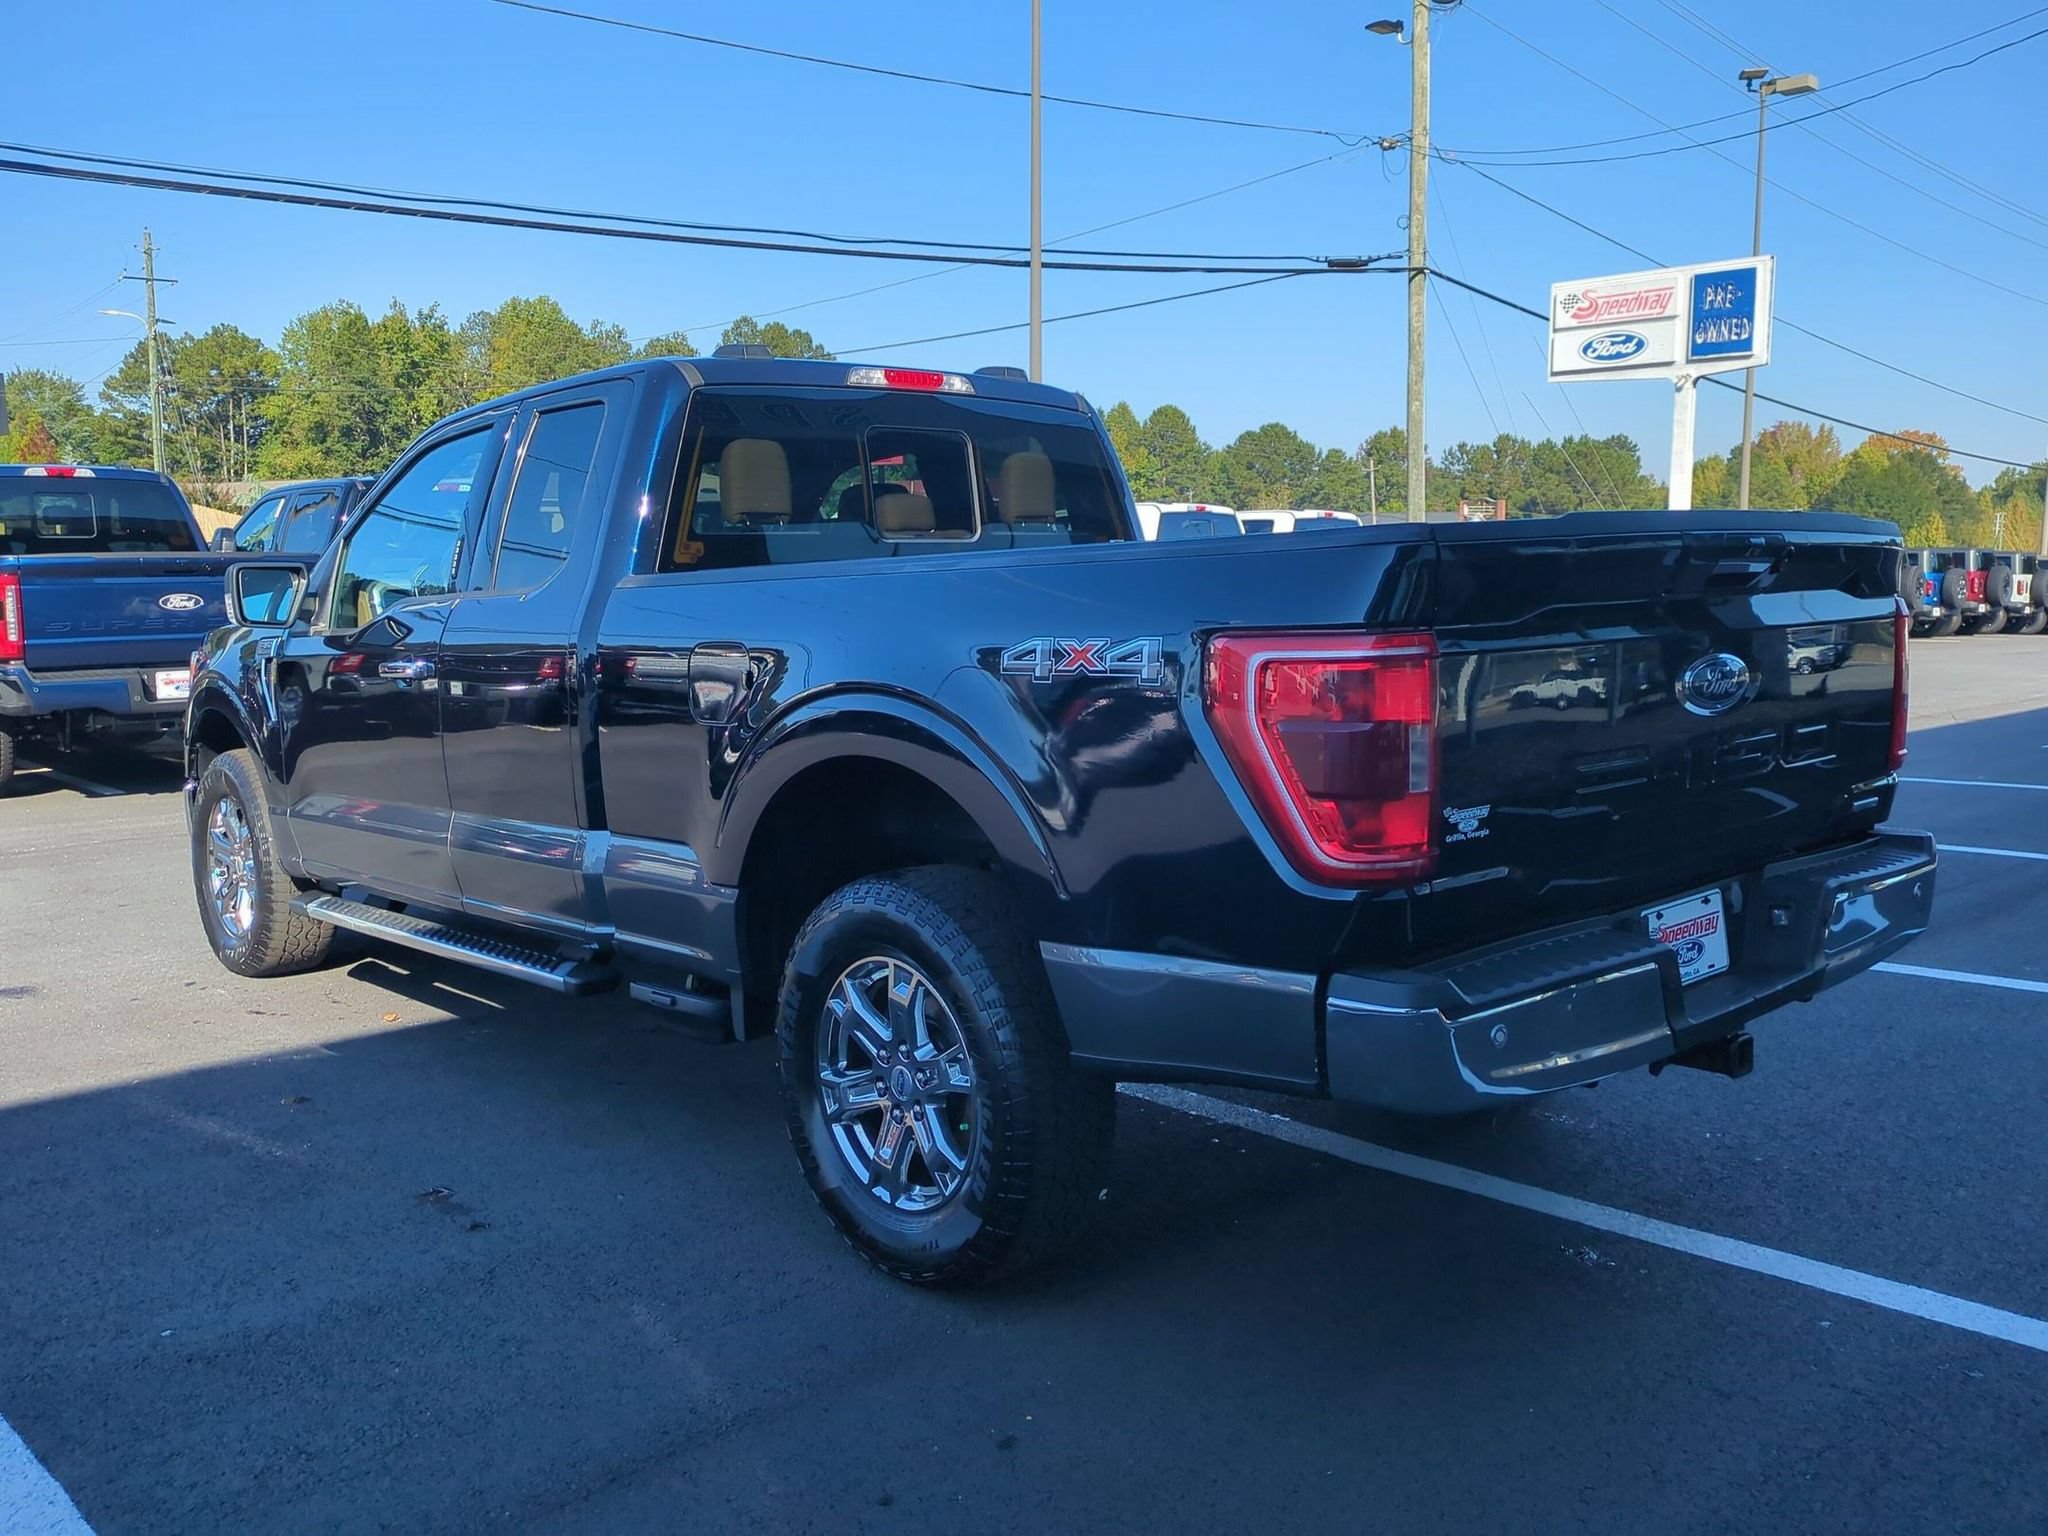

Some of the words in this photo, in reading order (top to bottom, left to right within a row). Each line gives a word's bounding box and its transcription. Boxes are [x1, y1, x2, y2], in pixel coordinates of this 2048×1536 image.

[1570, 287, 1675, 323] Speedway
[1695, 317, 1750, 344] OWNED
[1586, 334, 1638, 358] Ford
[166, 595, 196, 608] Ford
[1703, 667, 1739, 697] Ford
[1656, 911, 1720, 944] Speedway
[1677, 942, 1699, 962] Ford
